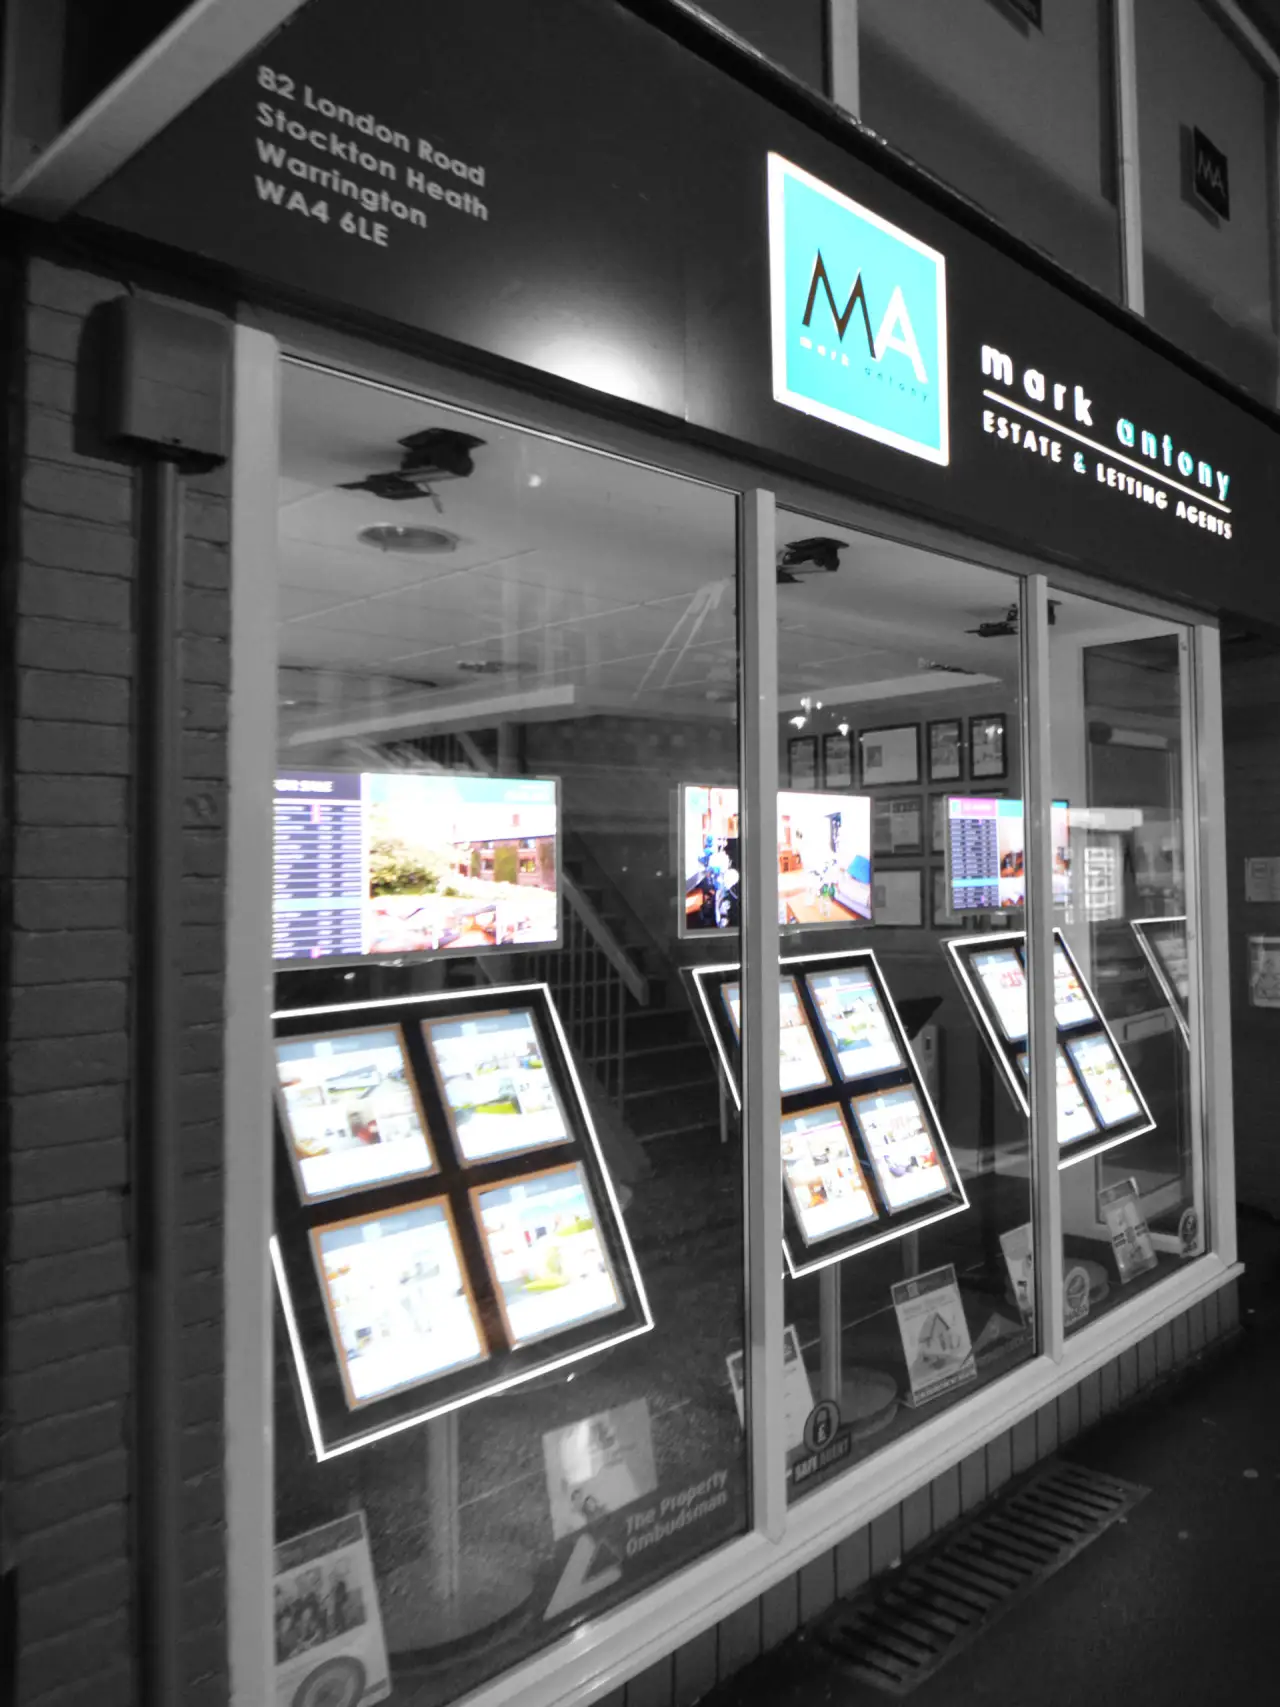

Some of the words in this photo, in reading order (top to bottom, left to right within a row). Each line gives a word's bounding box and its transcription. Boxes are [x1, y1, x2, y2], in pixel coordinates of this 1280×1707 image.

[256, 102, 396, 180] Stockton
[406, 166, 488, 221] Heath
[256, 137, 427, 228] Warrington
[257, 65, 295, 100] 82
[304, 85, 410, 153] London
[418, 138, 486, 187] Road
[255, 174, 330, 223] WA4
[339, 211, 388, 247] 6LE
[802, 248, 929, 384] MA
[981, 345, 1093, 427] mark
[1116, 418, 1230, 501] antony
[982, 410, 1062, 463] ESTATE
[1073, 451, 1087, 475] &
[1096, 463, 1168, 509] LETTING
[1175, 500, 1233, 540] AGENTS
[626, 1507, 657, 1537] The
[660, 1469, 728, 1518] Property
[626, 1489, 728, 1558] Ombudsman
